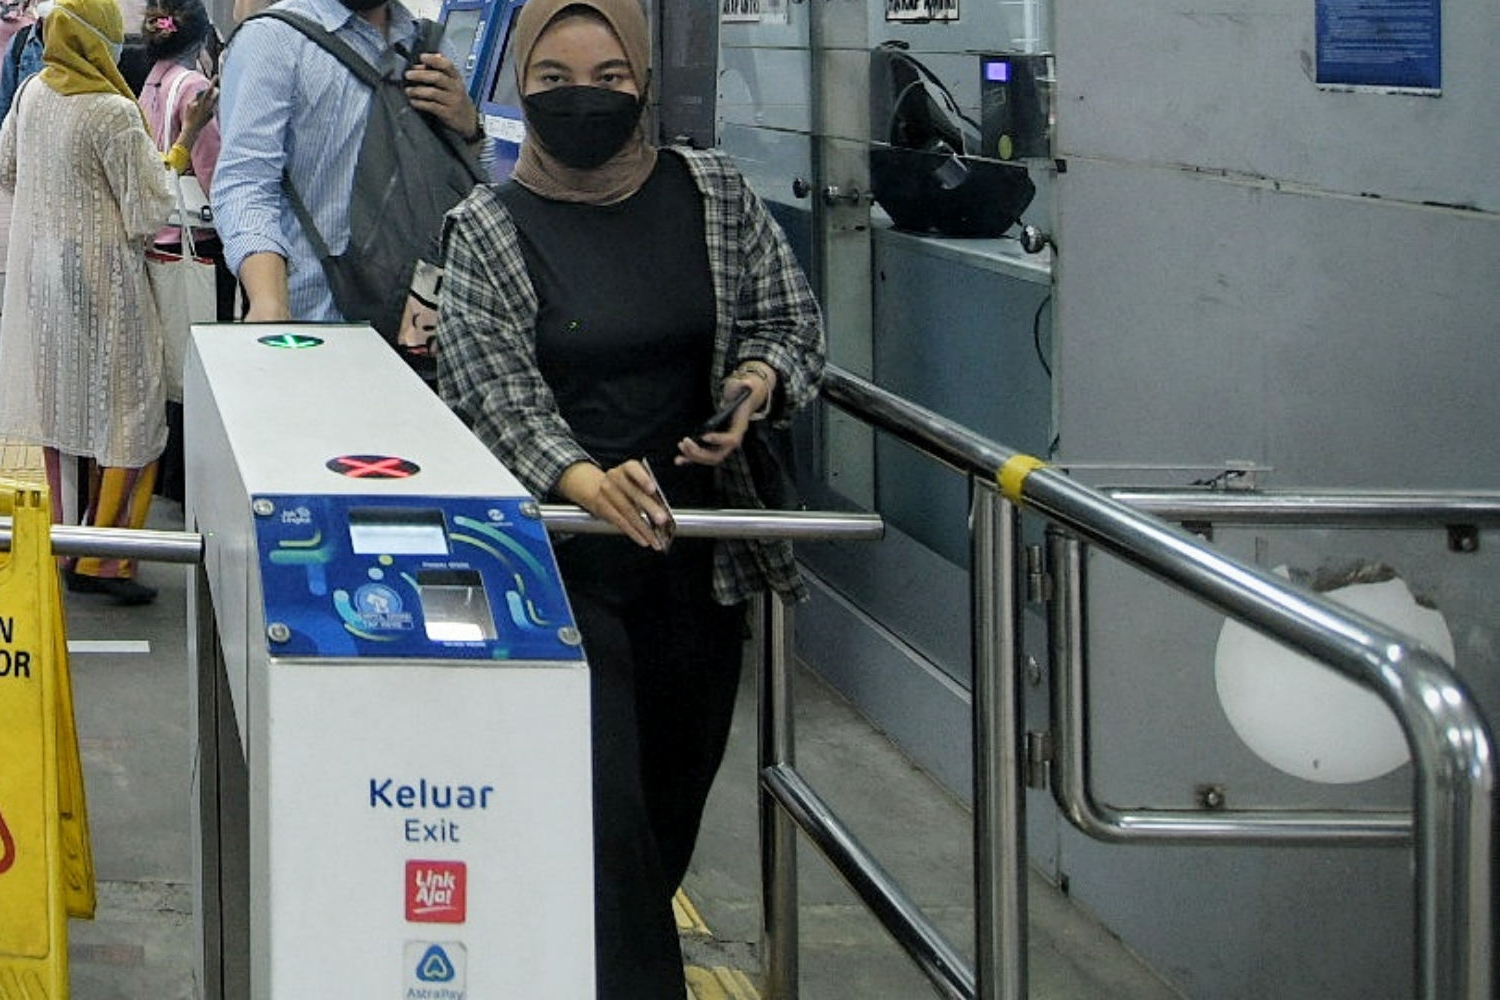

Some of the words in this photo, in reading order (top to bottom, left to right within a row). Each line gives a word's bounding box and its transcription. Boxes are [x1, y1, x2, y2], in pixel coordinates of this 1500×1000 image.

[369, 778, 494, 810] Keluar
[404, 818, 460, 843] Exit
[415, 869, 456, 890] Link
